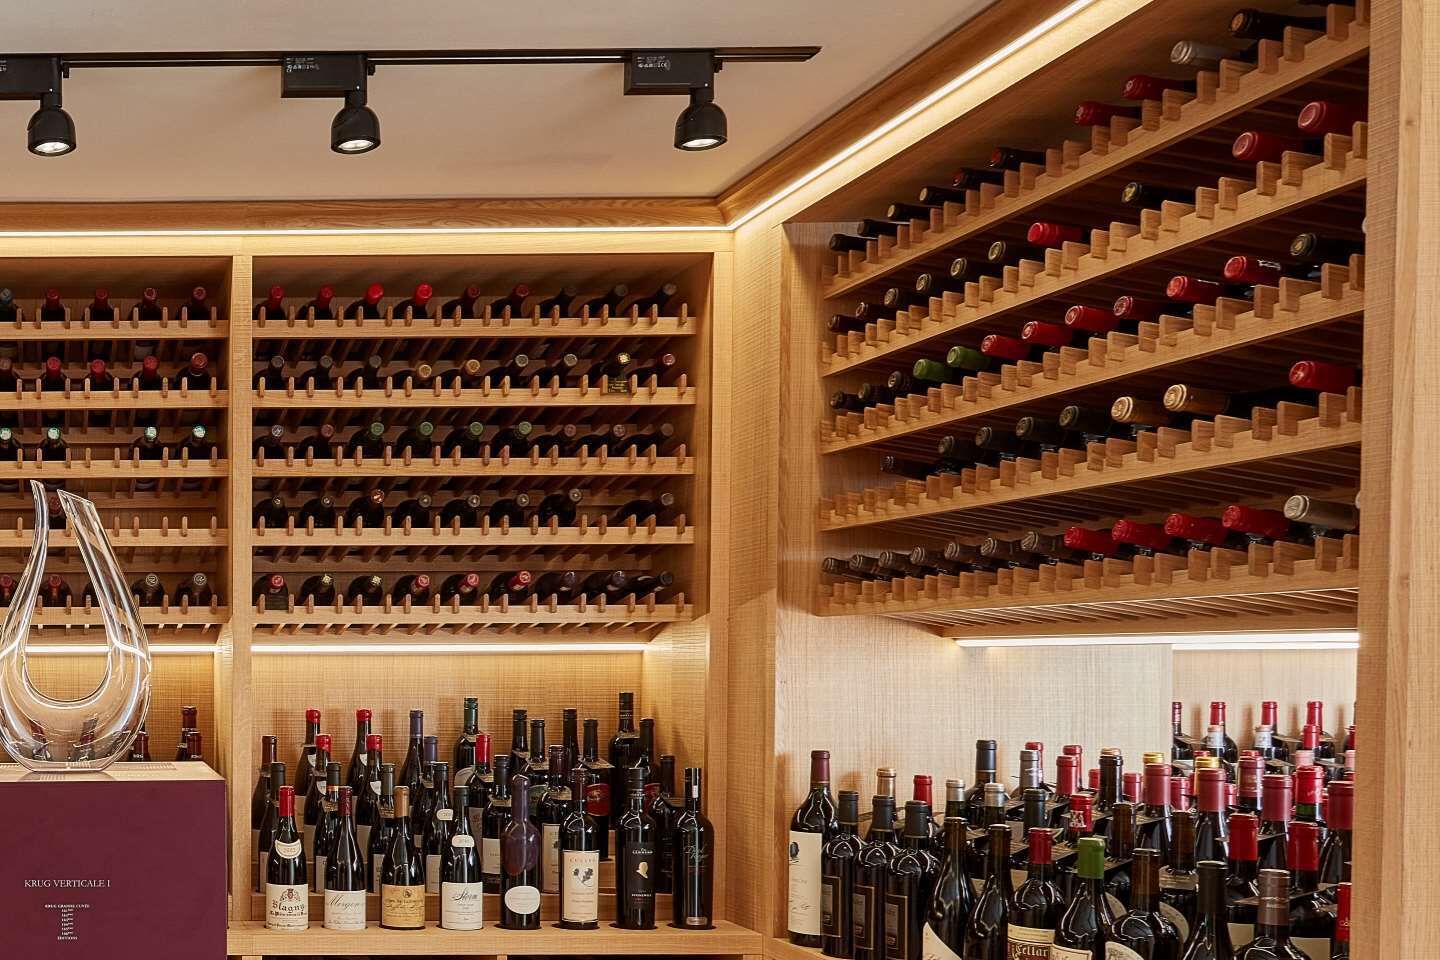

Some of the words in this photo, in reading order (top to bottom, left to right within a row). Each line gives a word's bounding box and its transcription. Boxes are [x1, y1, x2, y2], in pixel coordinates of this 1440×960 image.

[24, 879, 51, 888] KRUG
[53, 879, 105, 888] VERTICALE
[107, 879, 111, 888] I
